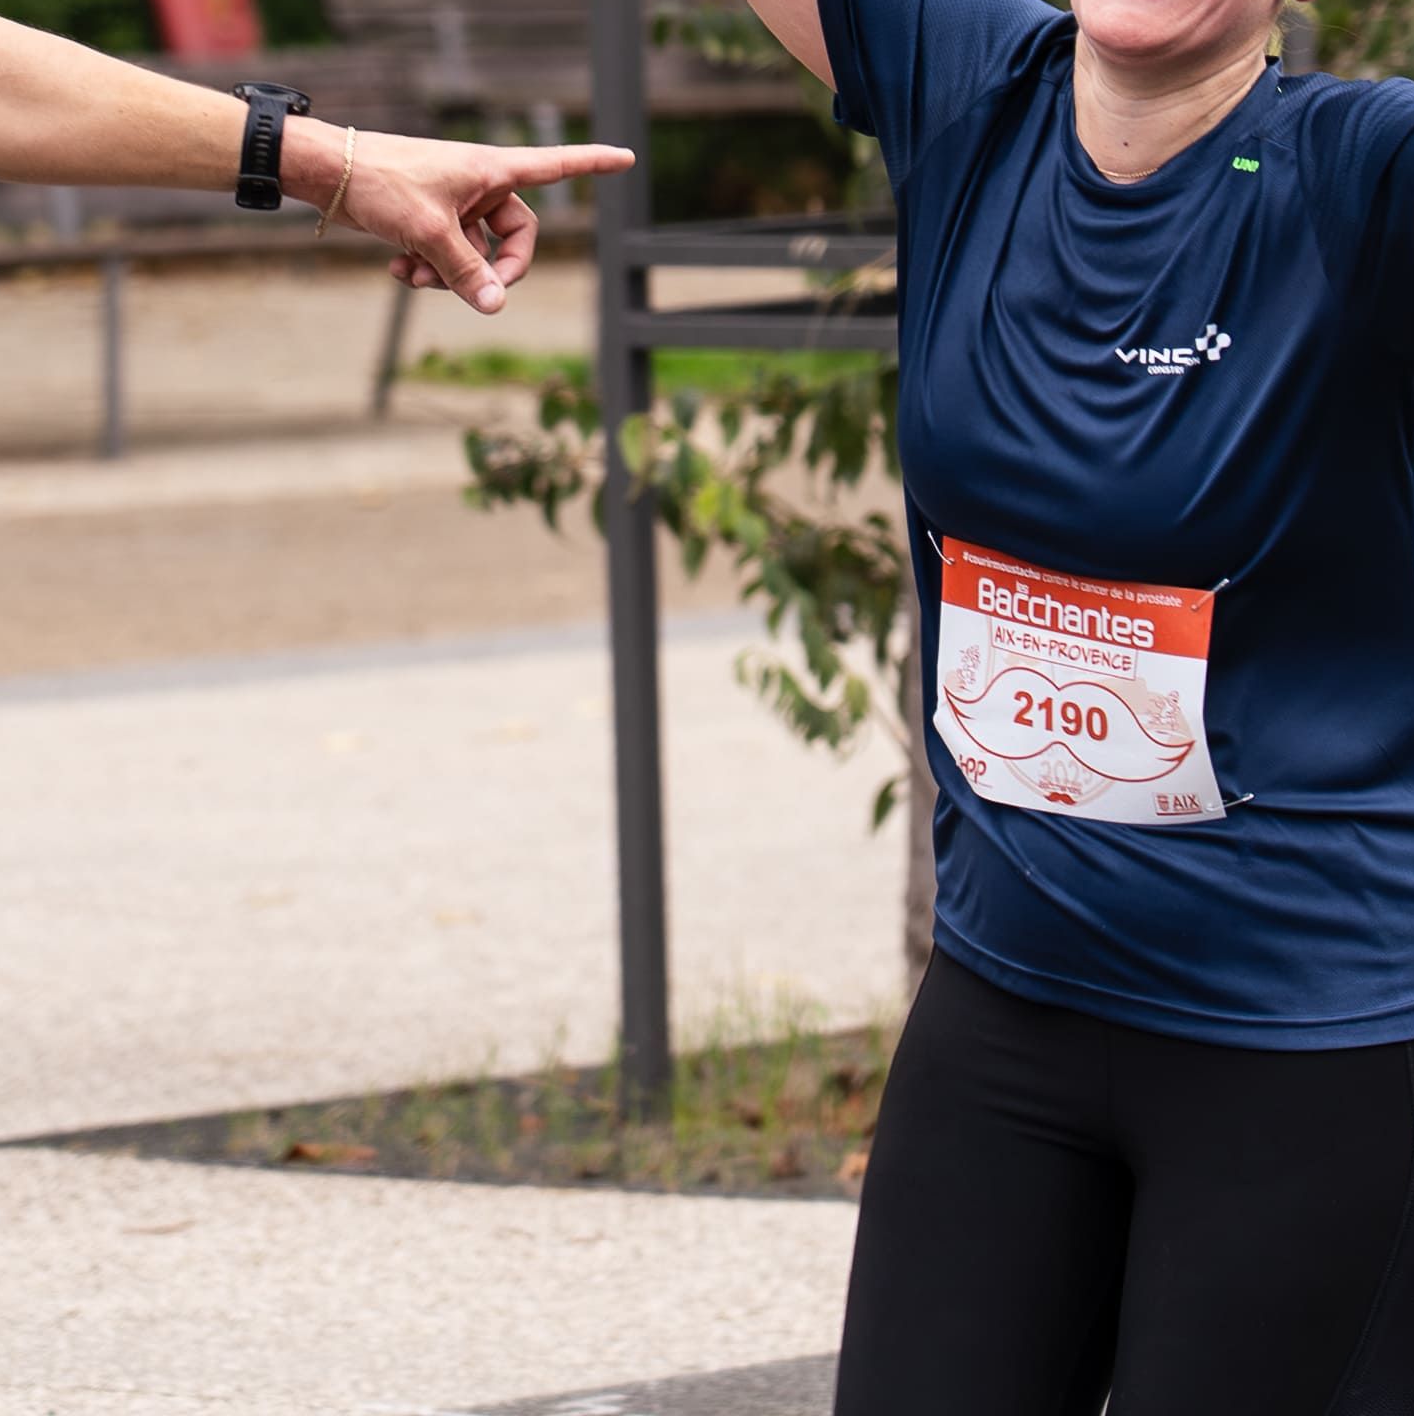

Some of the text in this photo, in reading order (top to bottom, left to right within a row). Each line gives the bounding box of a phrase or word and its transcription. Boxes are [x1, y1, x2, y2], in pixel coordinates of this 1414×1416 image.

[1114, 347, 1194, 364] VINC
[1042, 573, 1070, 588] contre
[1080, 582, 1108, 596] cancer
[1109, 587, 1123, 600] de
[1124, 589, 1135, 601] la
[1136, 592, 1183, 608] prostate
[977, 577, 1155, 649] Bacchantes
[994, 625, 1132, 672] AIX-EN-PROVENCE
[1013, 691, 1108, 742] 2190
[1173, 794, 1199, 811] AIX
